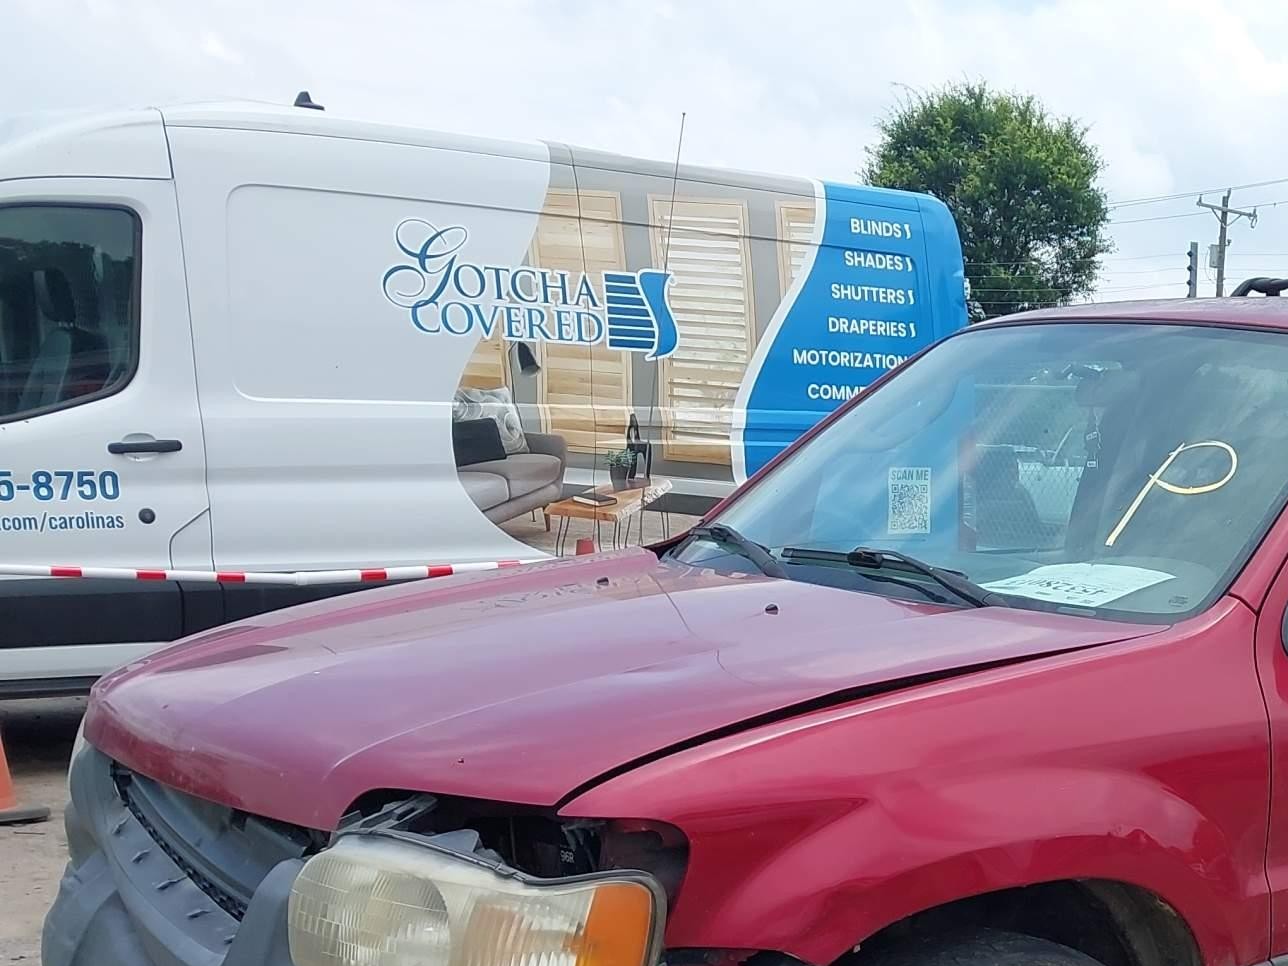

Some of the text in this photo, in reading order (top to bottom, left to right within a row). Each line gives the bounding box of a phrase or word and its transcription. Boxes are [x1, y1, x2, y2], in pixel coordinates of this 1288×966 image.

[850, 218, 902, 238] BLINDS
[382, 218, 602, 308] GOTCHA
[844, 250, 903, 271] SHADES
[831, 283, 905, 305] SHUTTERS
[411, 300, 604, 343] COVERED
[828, 317, 907, 338] DRAPERIES
[891, 469, 929, 481] SCAN ME
